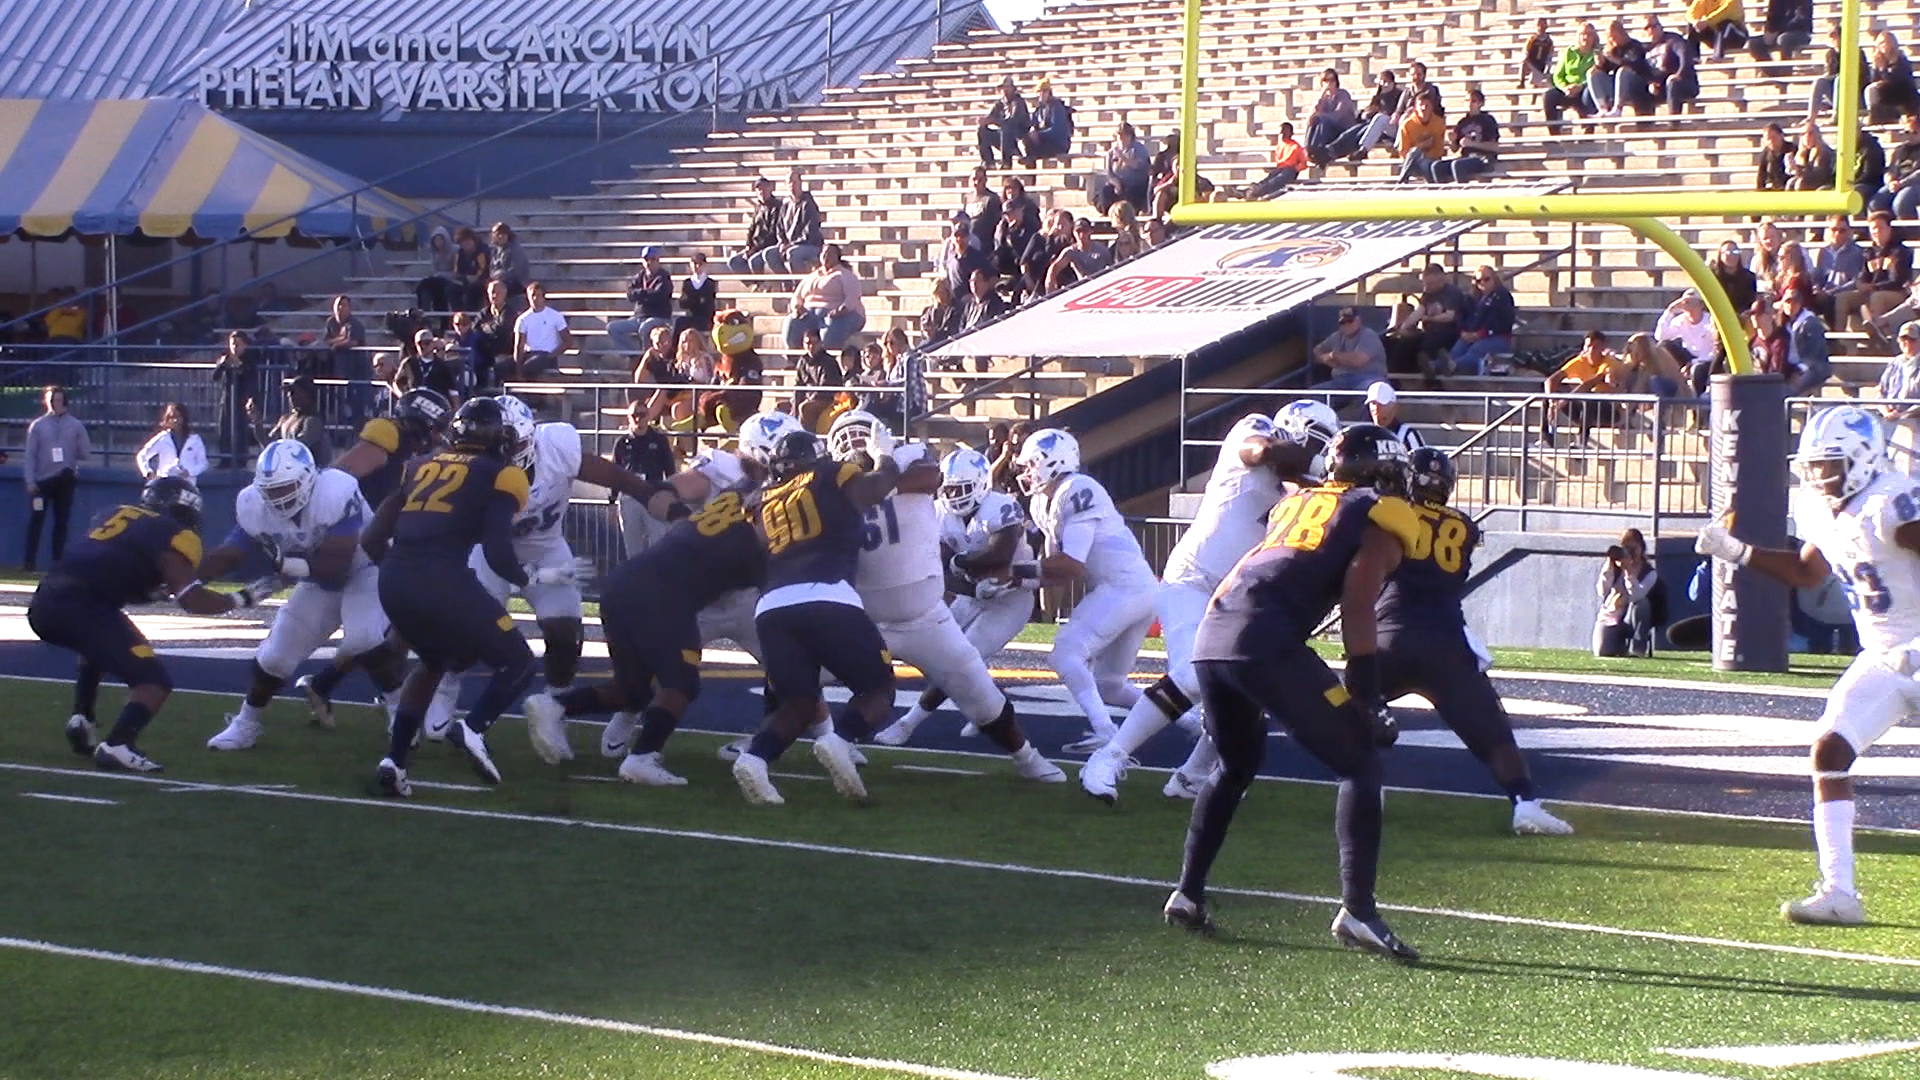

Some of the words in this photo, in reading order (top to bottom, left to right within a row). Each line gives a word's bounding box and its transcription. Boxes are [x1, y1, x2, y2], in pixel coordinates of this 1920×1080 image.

[273, 21, 351, 61] JIM
[367, 21, 461, 61] and
[477, 21, 711, 63] CAROLYN
[201, 67, 371, 108] PHELAN
[391, 67, 571, 110] VARSITY
[589, 67, 620, 108] K
[635, 68, 790, 110] ROOM
[1199, 222, 1272, 240] GO
[1077, 278, 1187, 306] 640
[1156, 277, 1326, 307] WHLO
[1720, 409, 1742, 511] KENT
[401, 461, 470, 513] 22
[1070, 487, 1095, 514] 12
[89, 507, 140, 540] 5
[762, 488, 822, 555] 90
[1261, 493, 1338, 552] 28
[1412, 503, 1467, 573] 58
[1720, 562, 1739, 662] TATE
